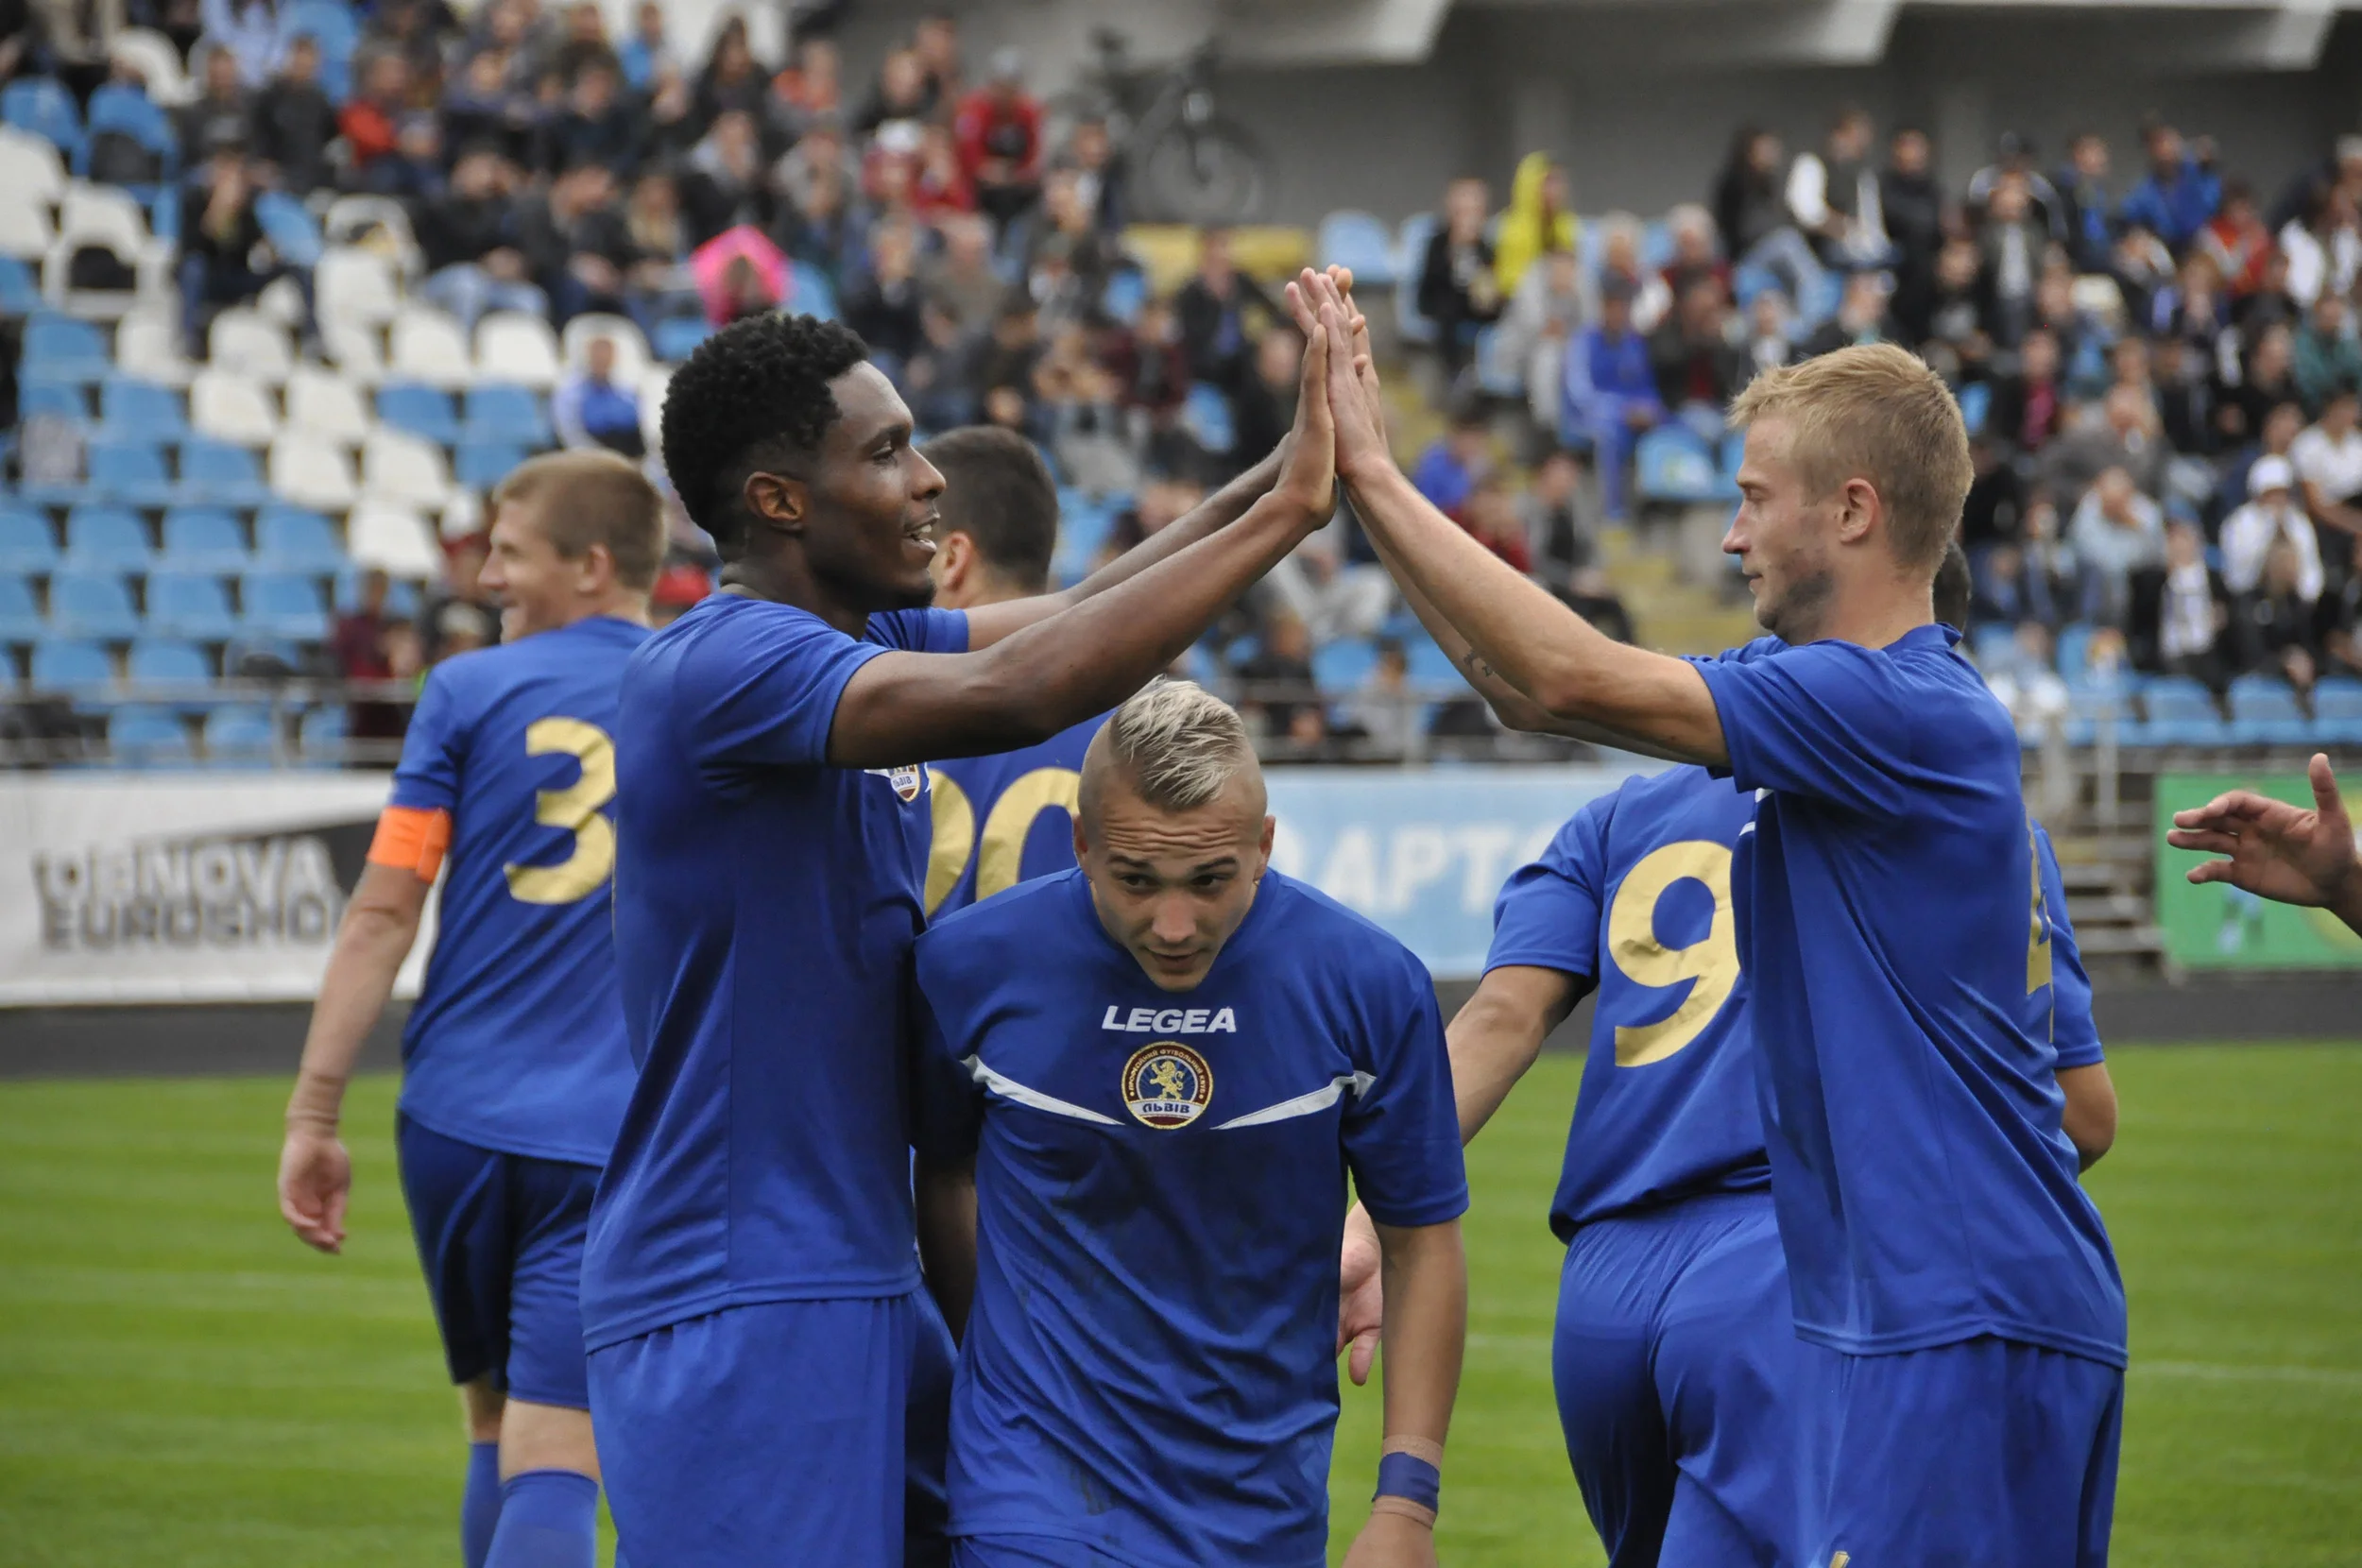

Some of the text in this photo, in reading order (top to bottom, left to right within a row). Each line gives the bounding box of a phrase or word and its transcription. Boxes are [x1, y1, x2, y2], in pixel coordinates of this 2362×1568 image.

[504, 716, 616, 904] 3
[1609, 840, 1740, 1068] 9
[1102, 1005, 1237, 1033] LEGEA
[1142, 1103, 1190, 1114] ЛЬВІВ
